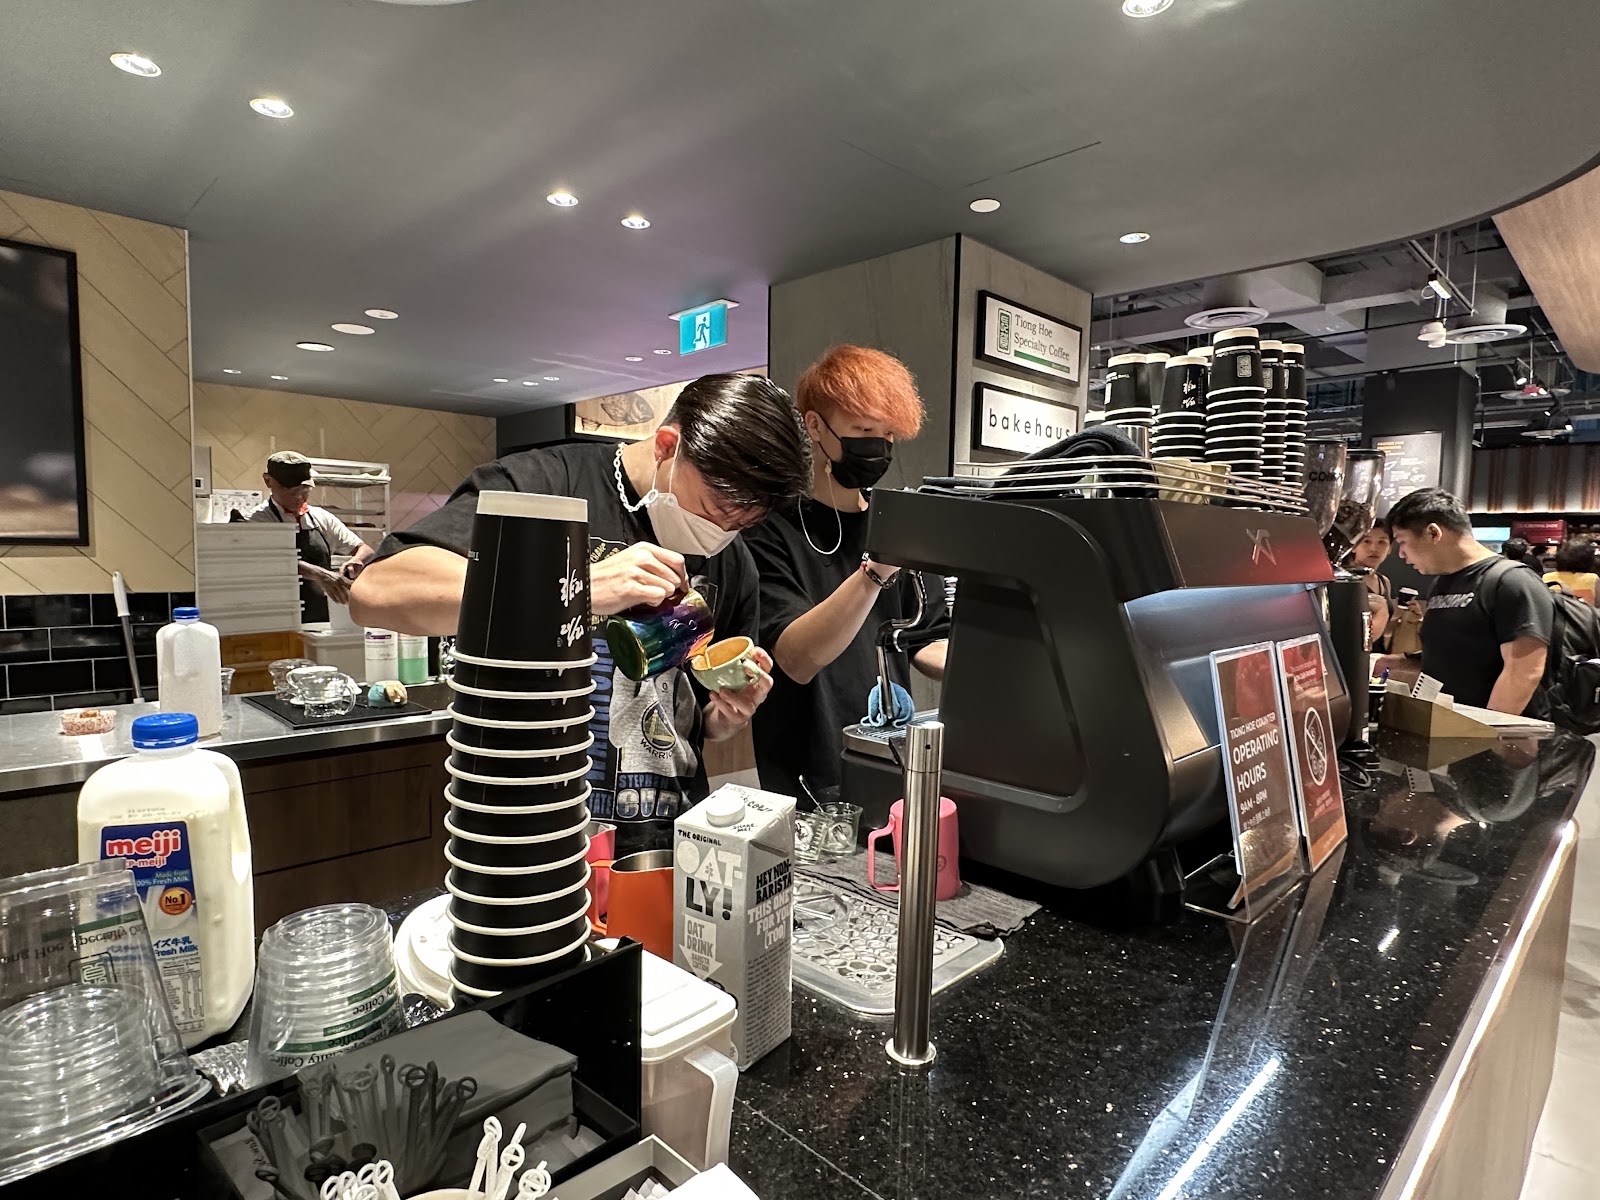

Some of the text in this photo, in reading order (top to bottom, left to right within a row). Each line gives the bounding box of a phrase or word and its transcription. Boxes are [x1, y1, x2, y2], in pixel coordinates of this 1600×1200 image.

[1014, 314, 1037, 336] Tiong
[1038, 322, 1053, 338] Hoe
[1013, 332, 1070, 361] Specialty Coffee
[1229, 711, 1276, 740] TIONG HOE COUNTER
[1232, 728, 1279, 765] OPERATING
[1236, 762, 1267, 794] HOURS
[616, 788, 680, 819] CUR
[105, 829, 181, 857] meiji
[677, 829, 722, 846] THE ORIGINAL
[174, 869, 189, 877] from
[677, 840, 743, 888] OAT-
[756, 858, 792, 890] HEY NON-
[136, 875, 190, 887] 00% Fresh Milk
[756, 872, 792, 905] BARISTA
[686, 876, 733, 921] LY!
[747, 900, 772, 924] THIS
[687, 919, 705, 939] OAT
[756, 913, 775, 936] FOR
[764, 920, 786, 950] (TOO)
[179, 944, 199, 954] Milk
[686, 935, 714, 959] DRINK
[270, 1054, 304, 1068] Coffee
